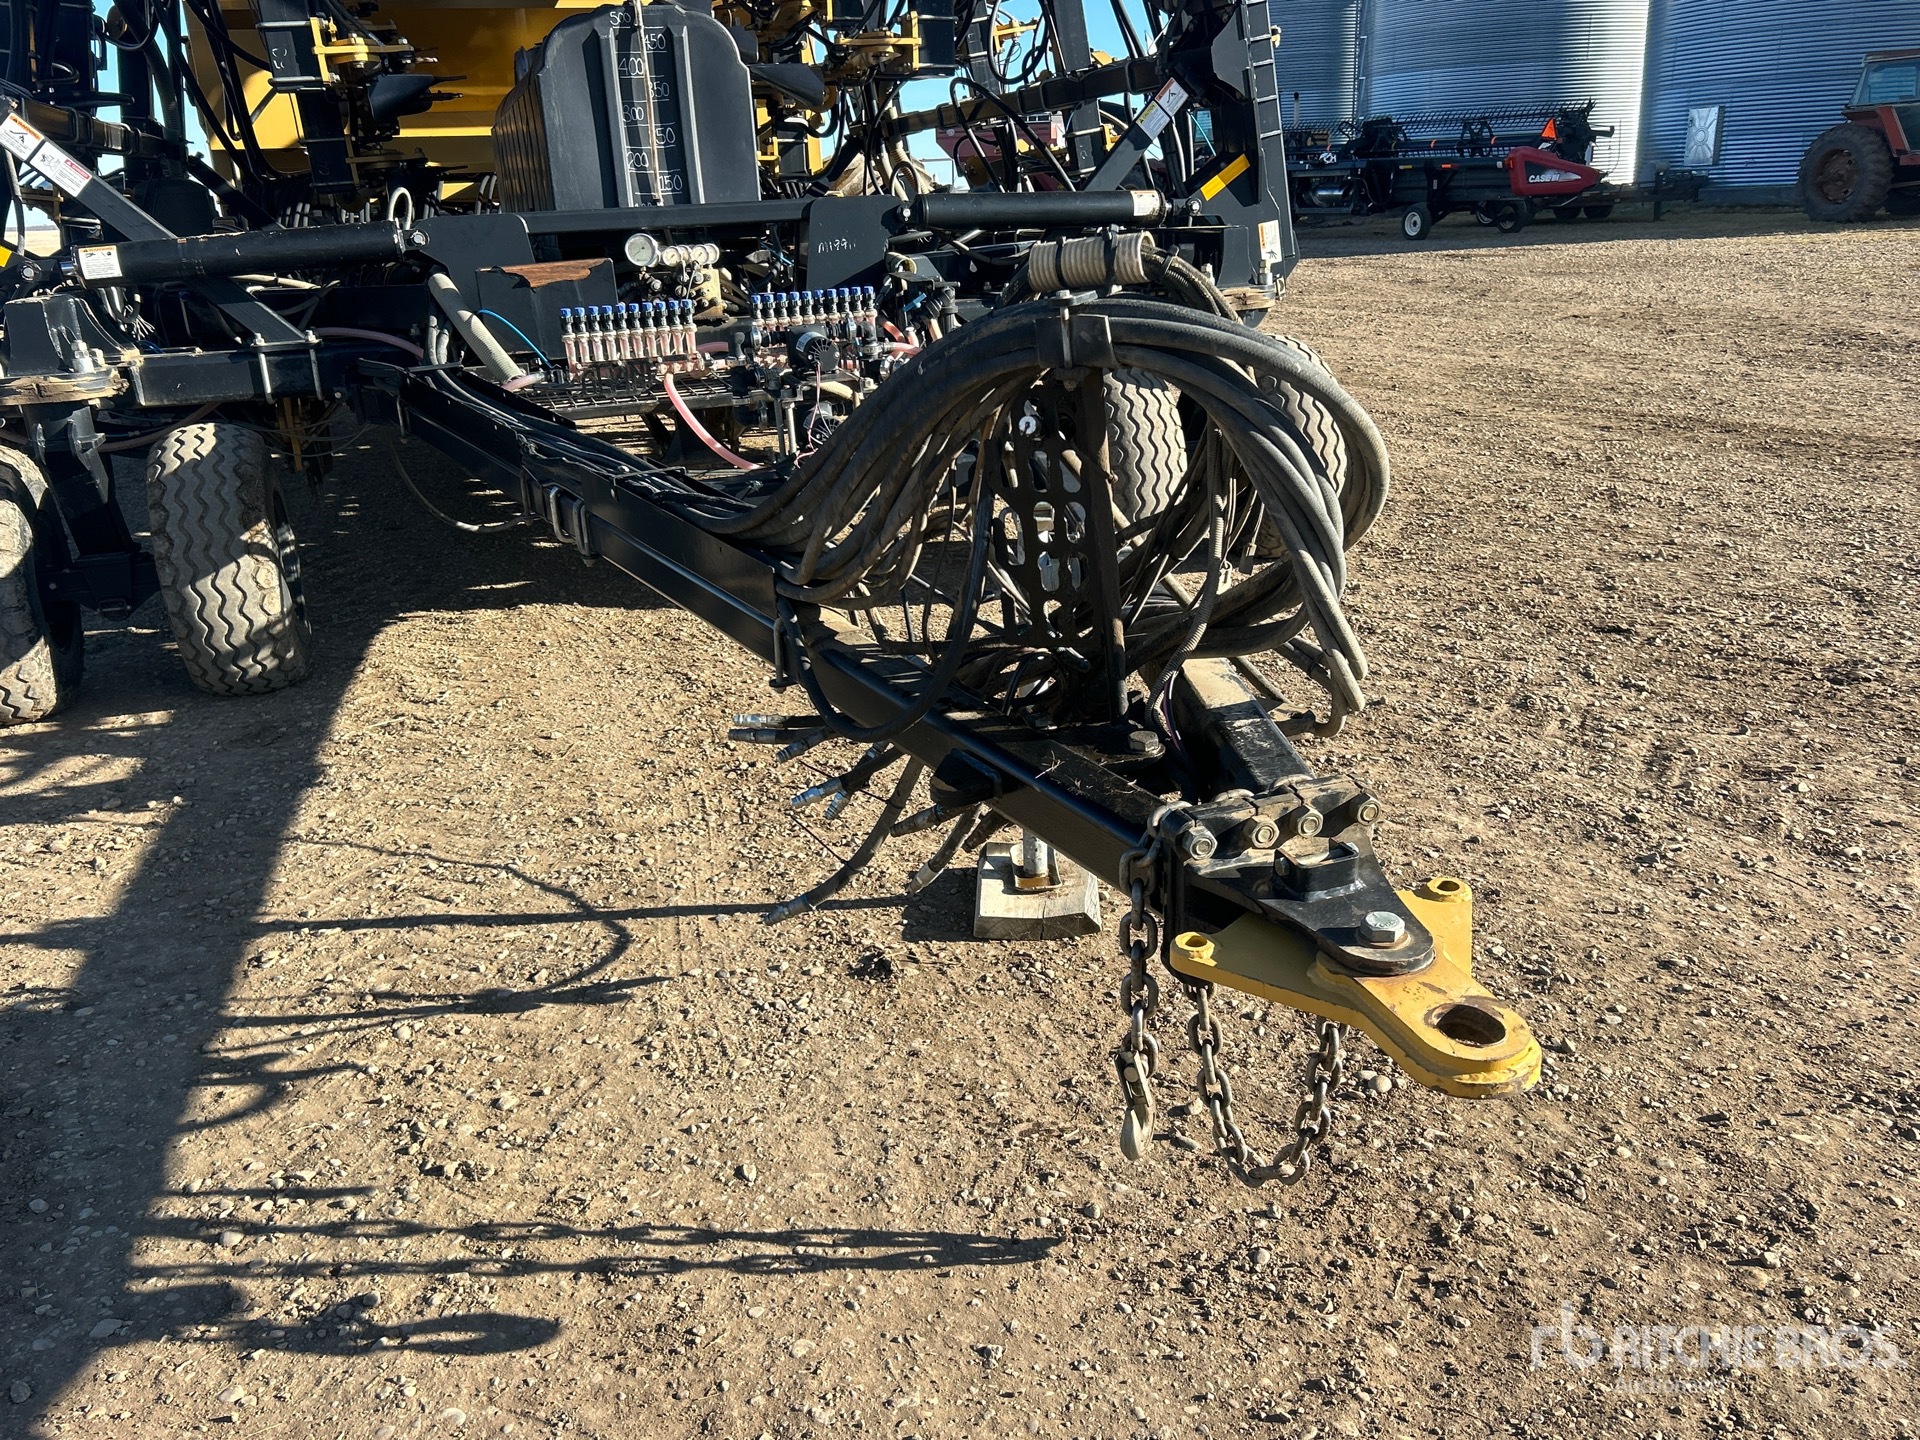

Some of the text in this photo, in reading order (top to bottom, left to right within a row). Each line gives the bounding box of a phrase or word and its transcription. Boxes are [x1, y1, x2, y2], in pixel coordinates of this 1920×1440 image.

[609, 11, 631, 26] 500
[644, 33, 666, 50] 450
[618, 57, 644, 76] 400
[622, 104, 645, 123] 300
[655, 127, 676, 145] 50
[626, 151, 649, 170] 200
[658, 174, 683, 192] 150
[1528, 174, 1551, 183] CASE
